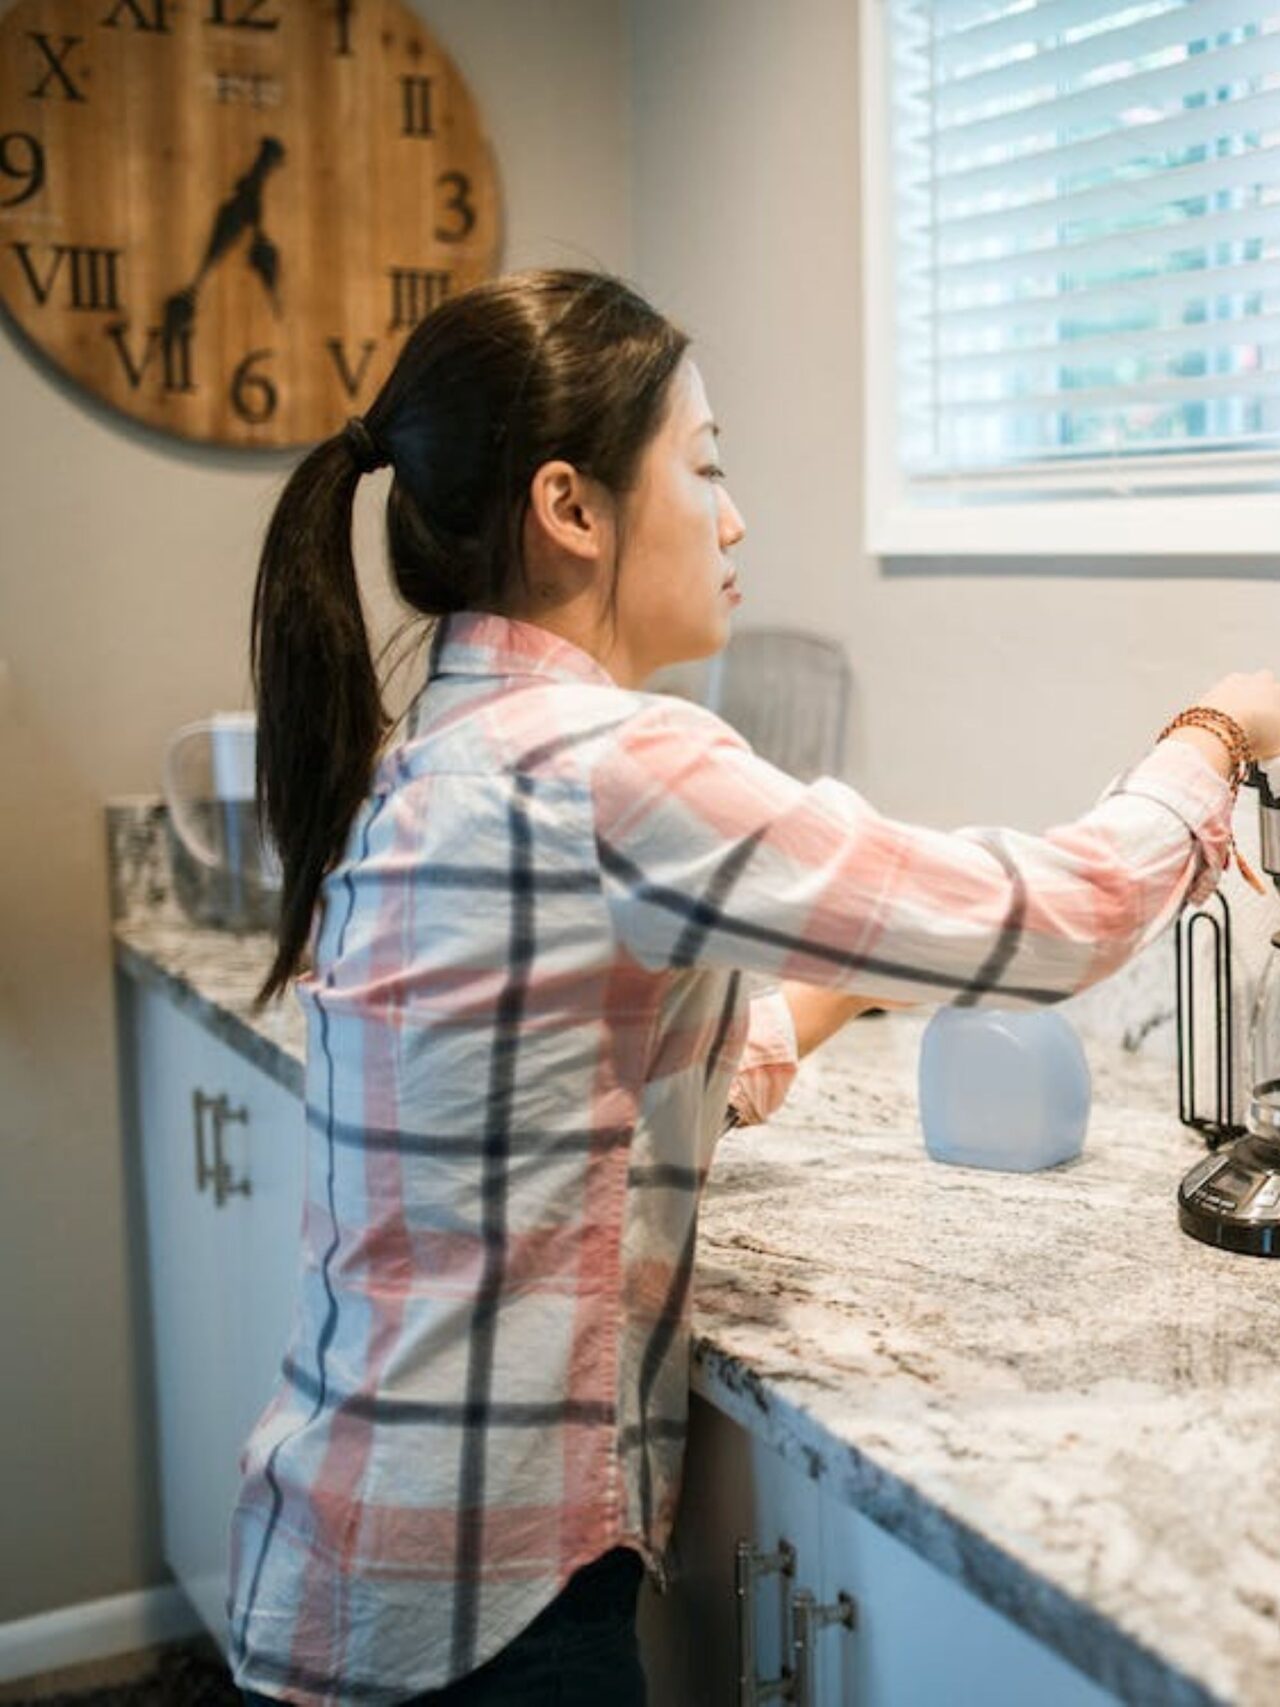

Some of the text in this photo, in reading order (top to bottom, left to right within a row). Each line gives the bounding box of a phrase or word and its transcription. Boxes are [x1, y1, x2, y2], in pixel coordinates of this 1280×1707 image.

[26, 31, 85, 102] X
[401, 75, 434, 138] II
[0, 132, 45, 207] 9
[434, 172, 475, 243] 3
[12, 242, 121, 312] VIII
[231, 348, 278, 424] 6
[328, 338, 376, 399] V
